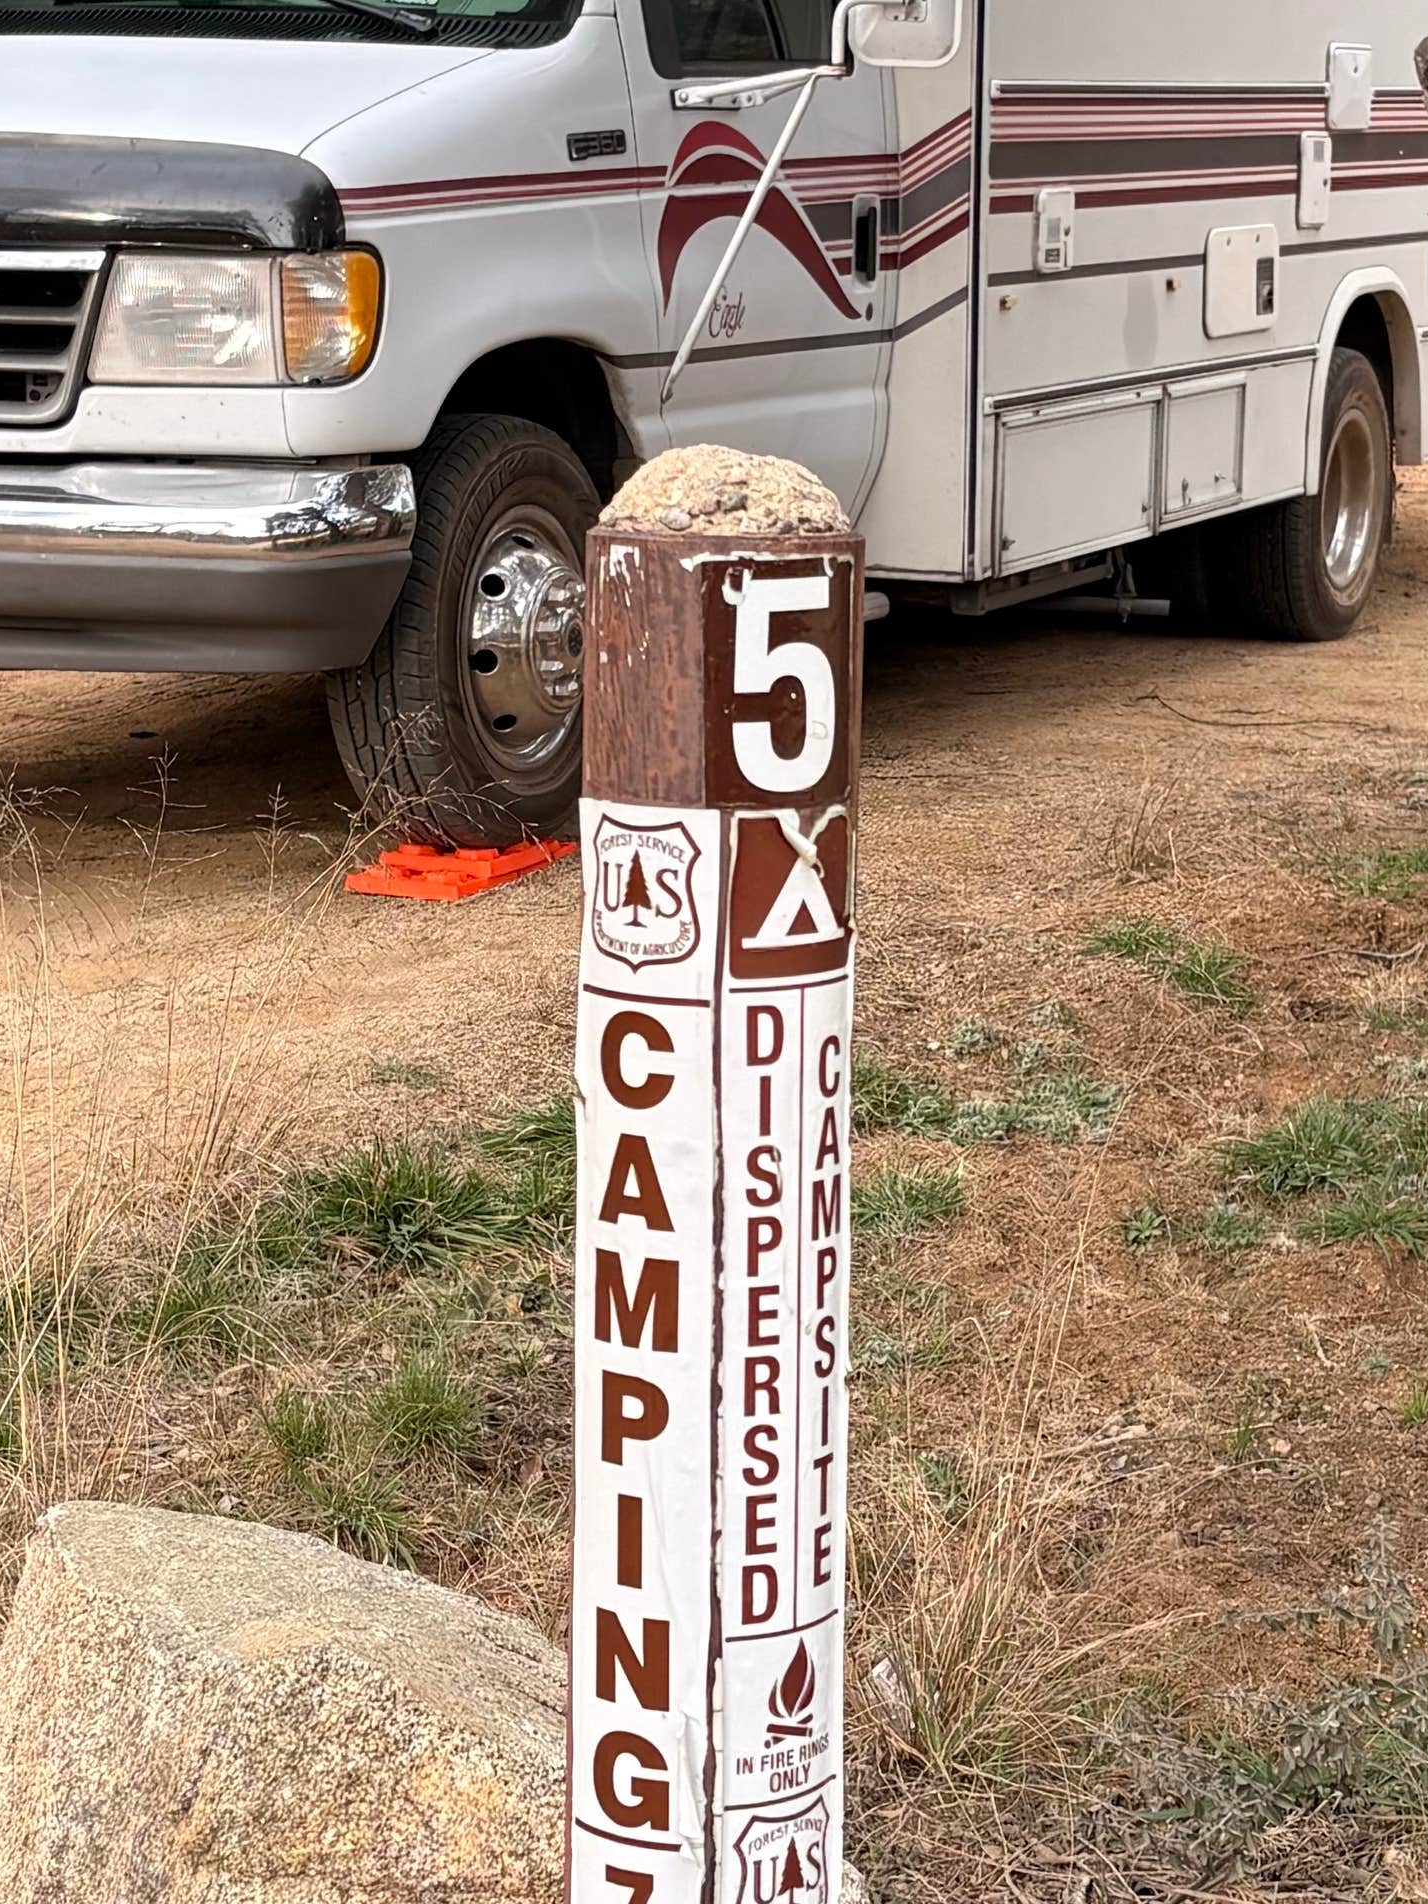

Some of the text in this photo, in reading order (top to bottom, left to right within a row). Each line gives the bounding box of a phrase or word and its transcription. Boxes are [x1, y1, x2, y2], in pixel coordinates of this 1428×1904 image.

[731, 575, 835, 794] 5
[600, 834, 685, 864] FOREST SERVICE
[740, 1005, 784, 1626] DISPERSED
[810, 1035, 840, 1587] CAMPSITE
[592, 1010, 680, 1832] CAMPING
[736, 1732, 829, 1775] IN FIRE RINGS
[769, 1761, 811, 1793] ONLY
[748, 1824, 789, 1856] FOREST
